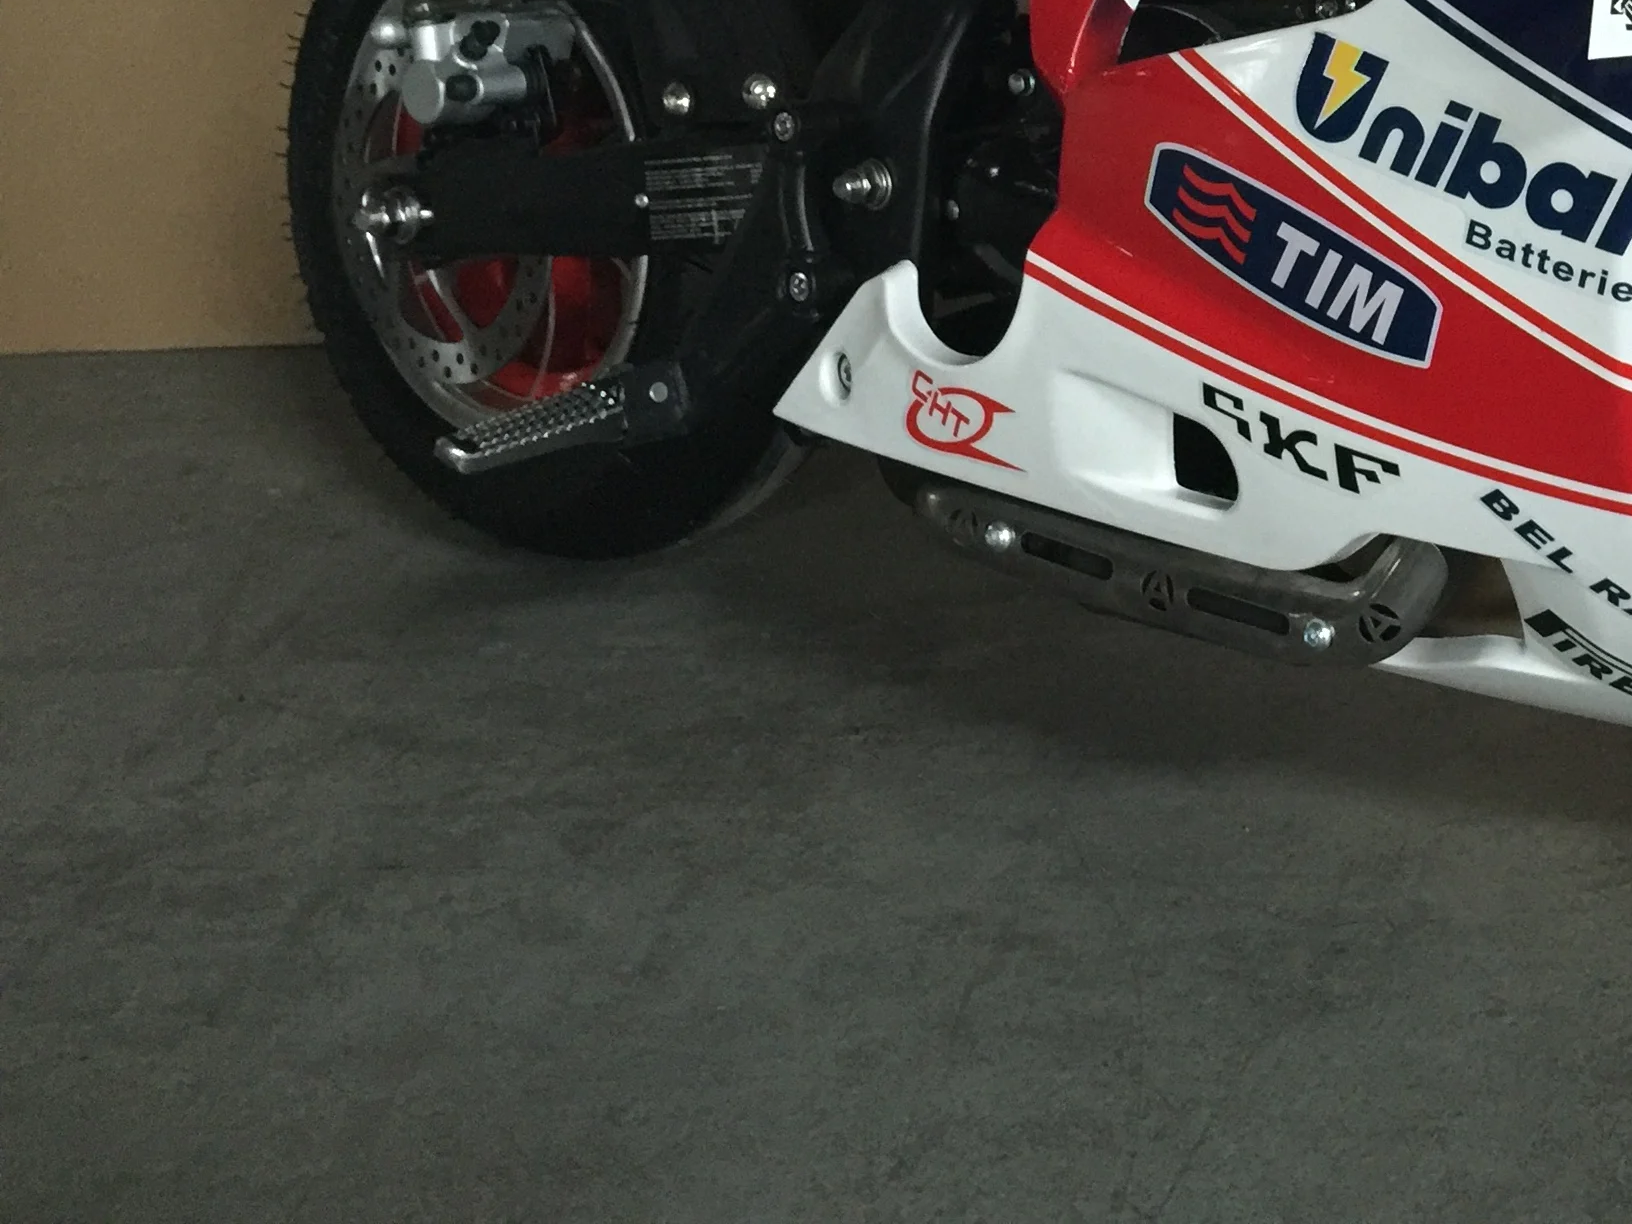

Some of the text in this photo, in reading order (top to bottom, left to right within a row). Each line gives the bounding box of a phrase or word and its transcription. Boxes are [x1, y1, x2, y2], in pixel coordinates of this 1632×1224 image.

[1269, 223, 1405, 346] TIM
[912, 370, 970, 437] CHT
[1201, 382, 1402, 494] SKF
[1480, 489, 1576, 573] BEL
